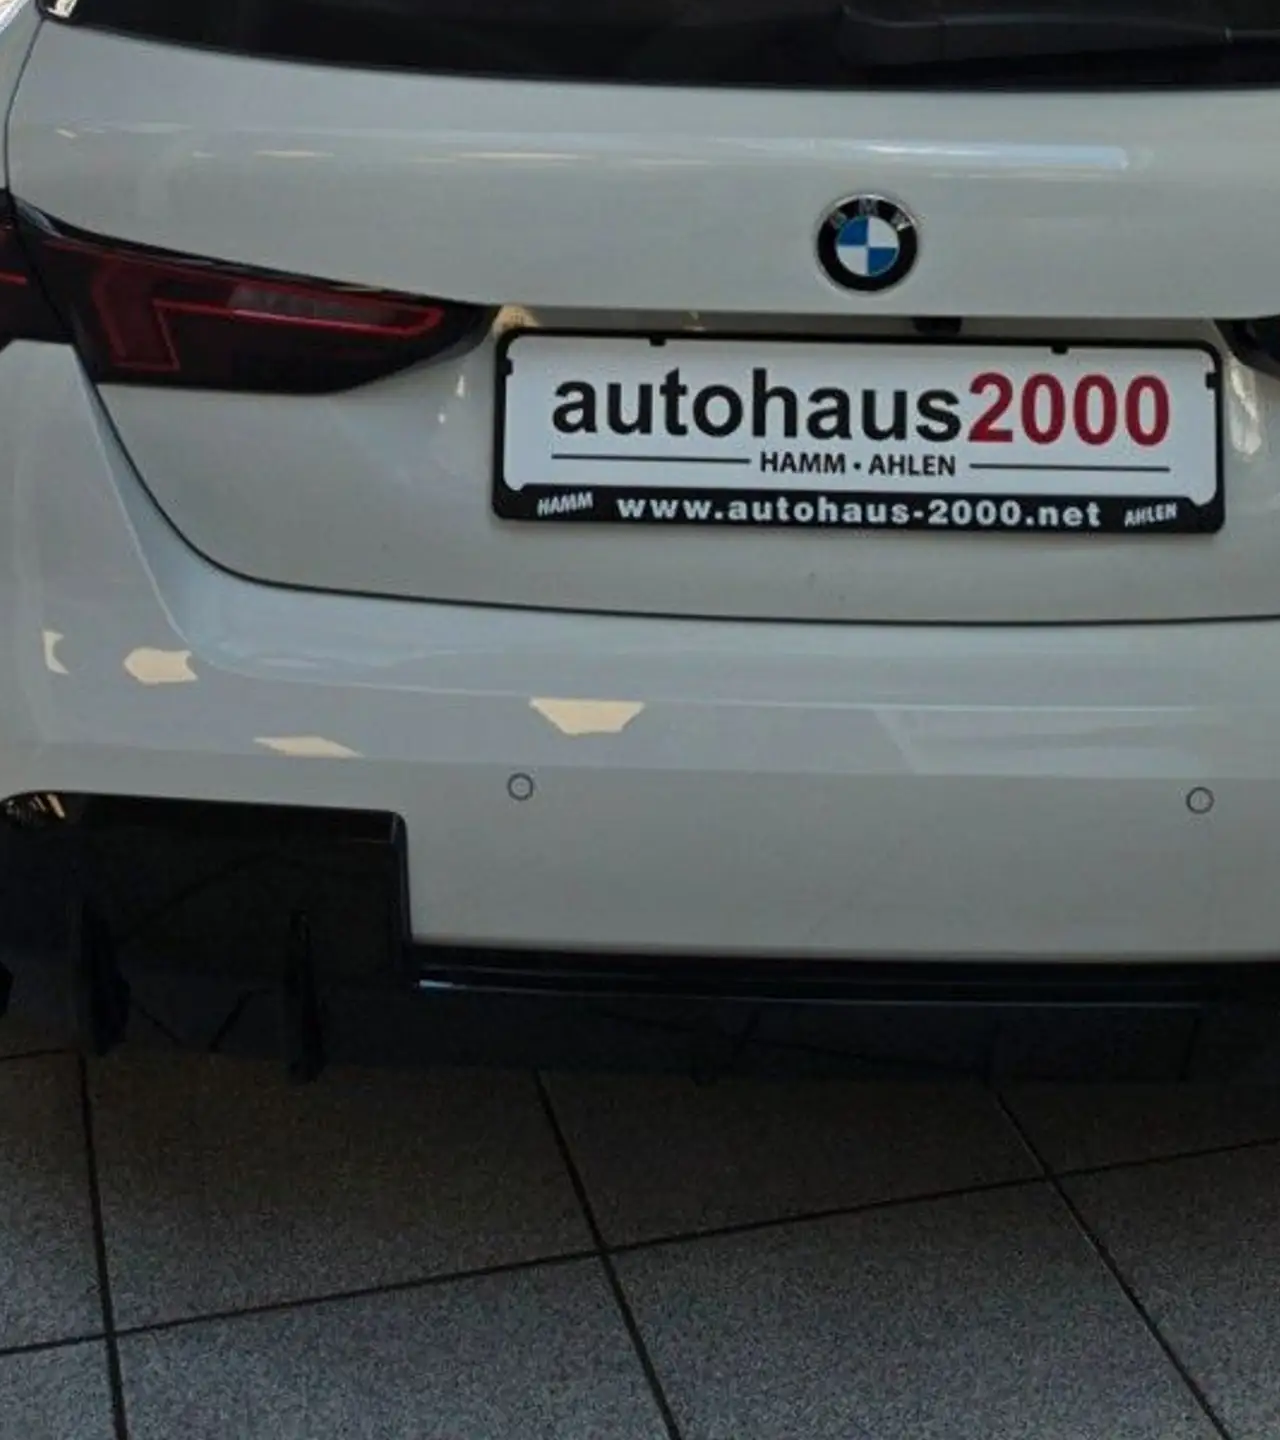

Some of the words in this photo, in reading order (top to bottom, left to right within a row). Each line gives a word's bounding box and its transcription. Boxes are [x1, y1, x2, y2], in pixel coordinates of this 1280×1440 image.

[760, 451, 847, 474] HAMM
[868, 453, 956, 477] AHLEN
[537, 491, 594, 517] HAMM
[617, 496, 1102, 527] www.autohaus-2000.net
[1124, 502, 1179, 527] AHLEN
